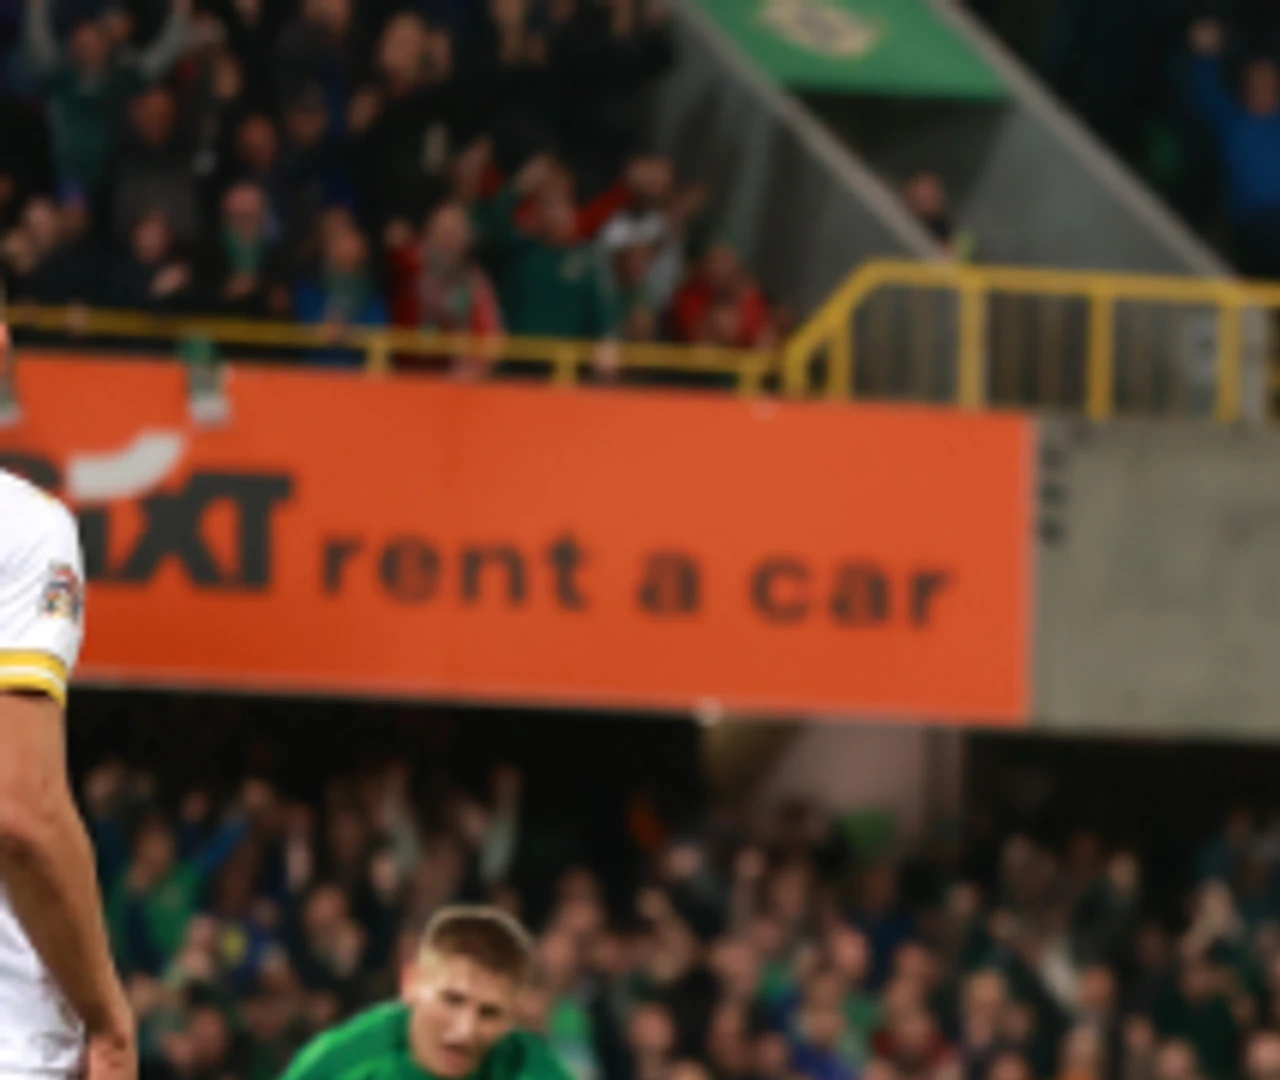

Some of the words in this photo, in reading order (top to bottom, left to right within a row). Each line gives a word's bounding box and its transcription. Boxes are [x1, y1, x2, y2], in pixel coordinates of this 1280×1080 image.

[0, 450, 293, 591] IXT
[320, 531, 592, 612] rent
[636, 546, 703, 622] a
[748, 555, 957, 632] car
